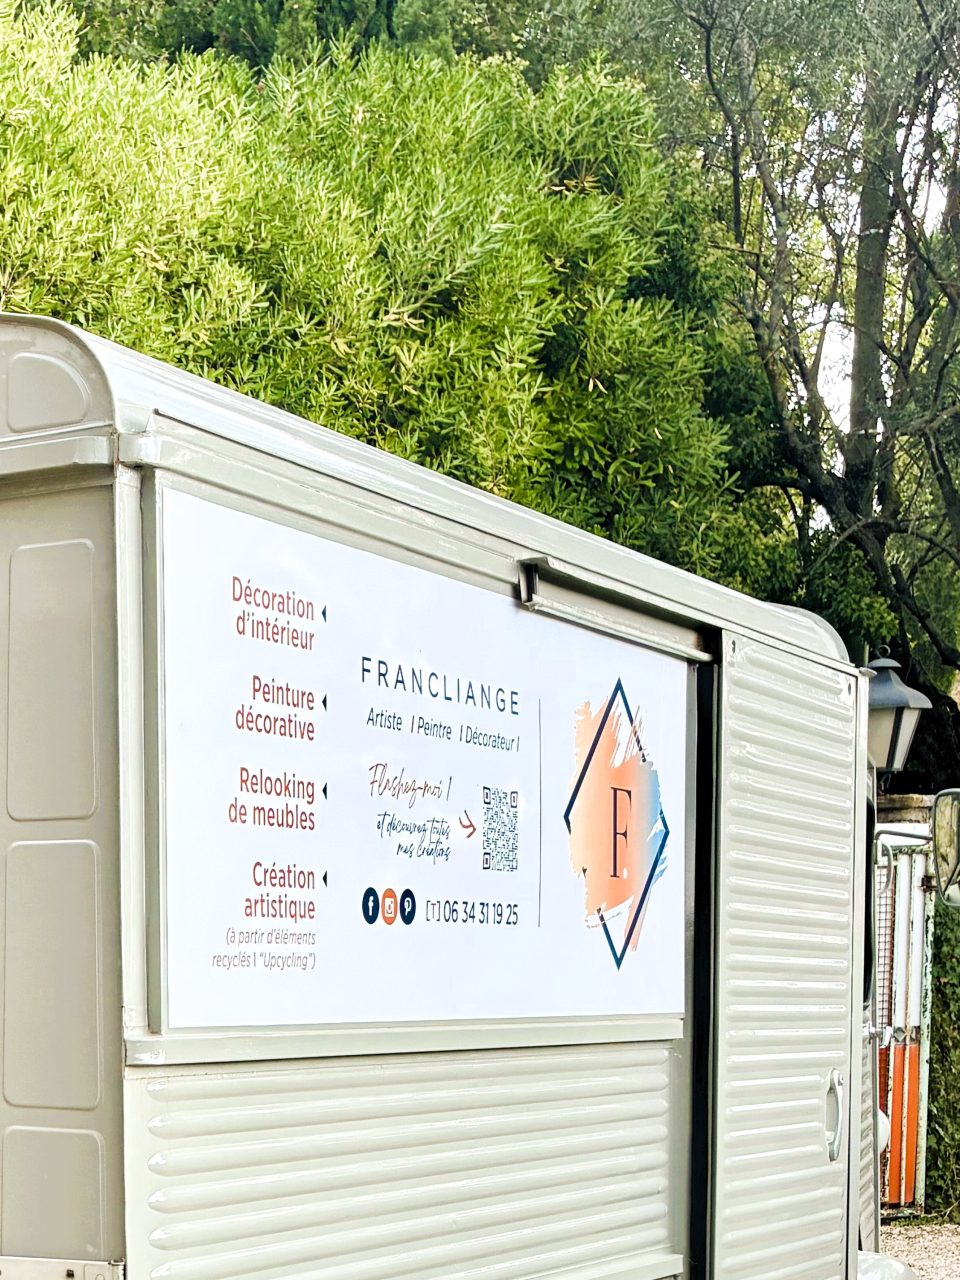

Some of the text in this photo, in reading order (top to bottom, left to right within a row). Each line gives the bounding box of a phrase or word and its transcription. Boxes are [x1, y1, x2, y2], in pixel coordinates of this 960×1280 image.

[232, 576, 315, 621] Décoration
[252, 675, 315, 711] Peinture
[361, 656, 519, 716] FRANCLIANGE
[236, 704, 315, 742] décorative
[366, 707, 403, 732] Artiste
[417, 716, 452, 741] Peintre
[465, 725, 515, 751] Décorateur
[240, 767, 315, 805] Relooking
[228, 797, 315, 831] de meubles
[610, 786, 632, 879] F
[252, 861, 315, 889] Création
[244, 893, 316, 923] artistique
[443, 900, 459, 923] 06
[461, 901, 476, 924] 34
[478, 902, 489, 924] 31
[492, 903, 503, 925] 19
[505, 904, 519, 926] 25
[238, 930, 265, 946] partir
[212, 951, 251, 970] recyclés
